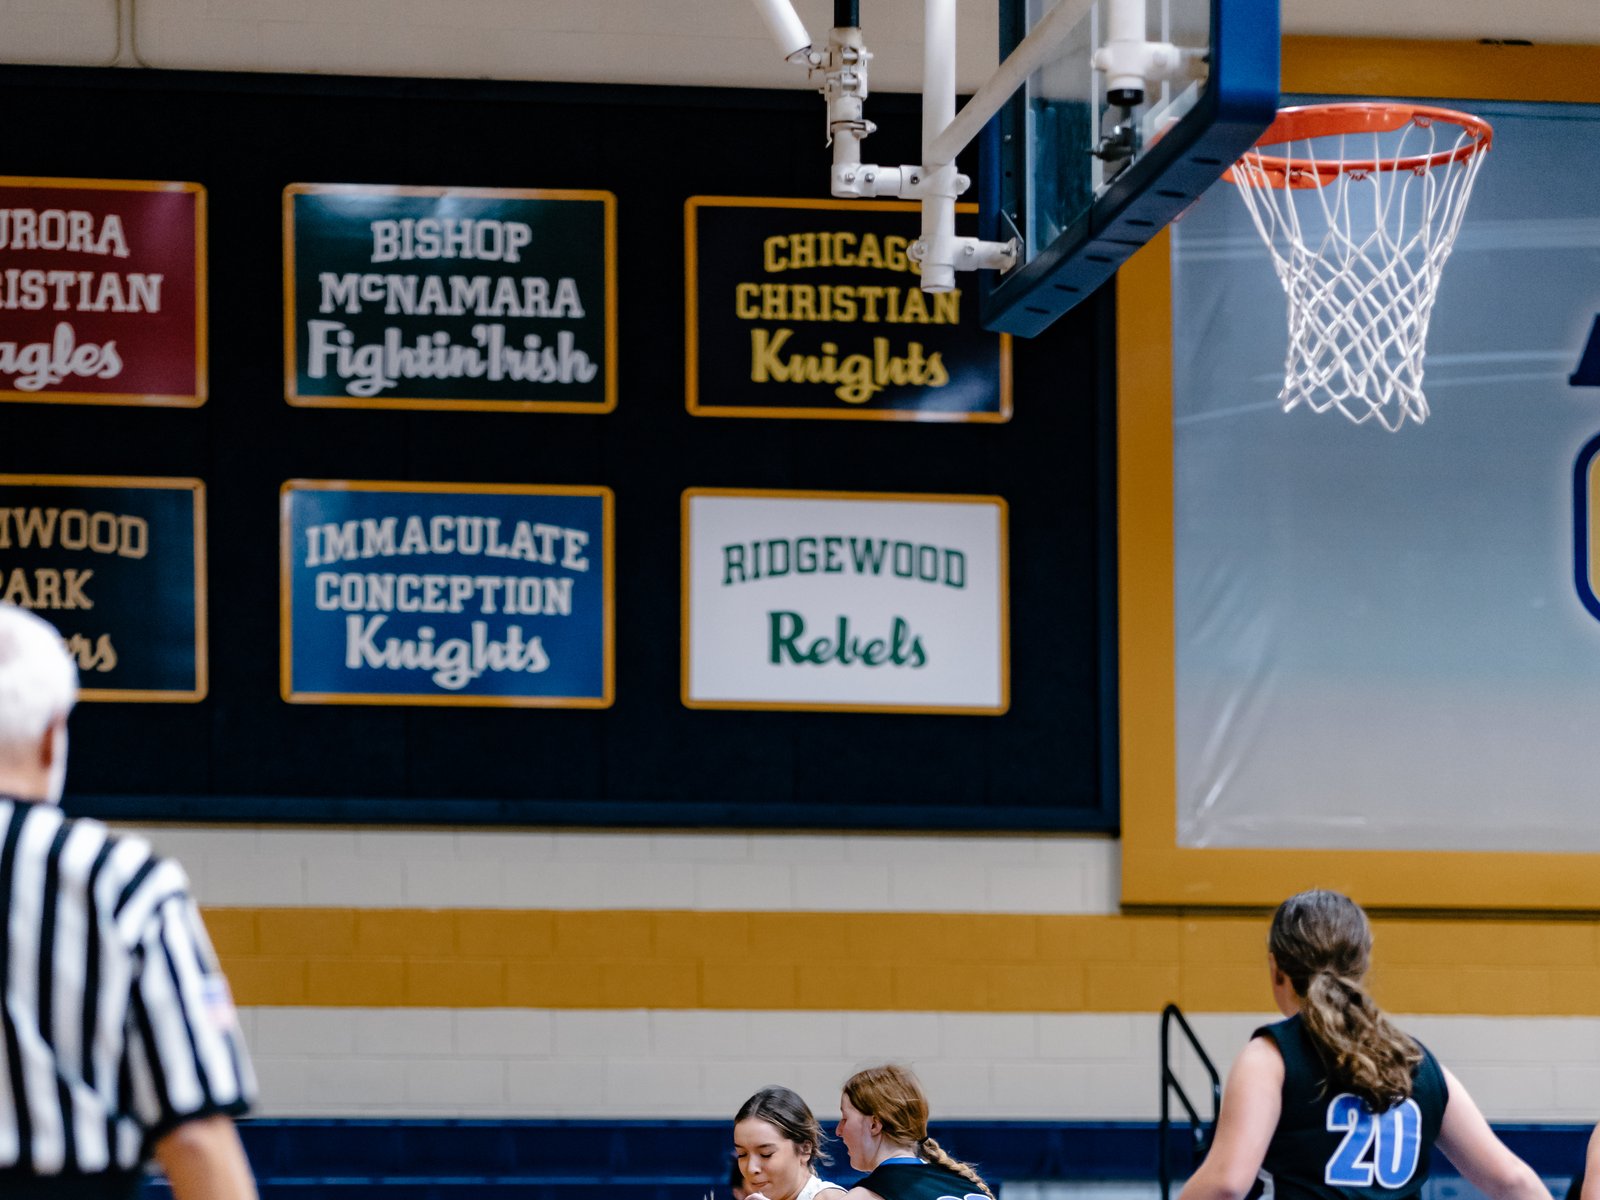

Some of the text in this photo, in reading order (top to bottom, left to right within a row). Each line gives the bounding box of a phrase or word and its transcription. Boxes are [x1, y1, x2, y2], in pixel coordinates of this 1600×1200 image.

[370, 219, 532, 263] BISHOP
[763, 231, 922, 274] CHICAG
[0, 268, 164, 313] ISTIAN
[735, 282, 962, 325] CHRISTIAN
[750, 328, 950, 403] Knights
[0, 506, 148, 559] WOOD
[305, 515, 589, 571] IMMACULATE
[0, 567, 94, 610] ARK
[721, 536, 968, 590] RIDGEWOOD
[315, 572, 573, 615] CONCEPTION
[345, 614, 550, 690] Knights
[766, 610, 928, 669] Rebels
[1325, 1092, 1422, 1189] 20
